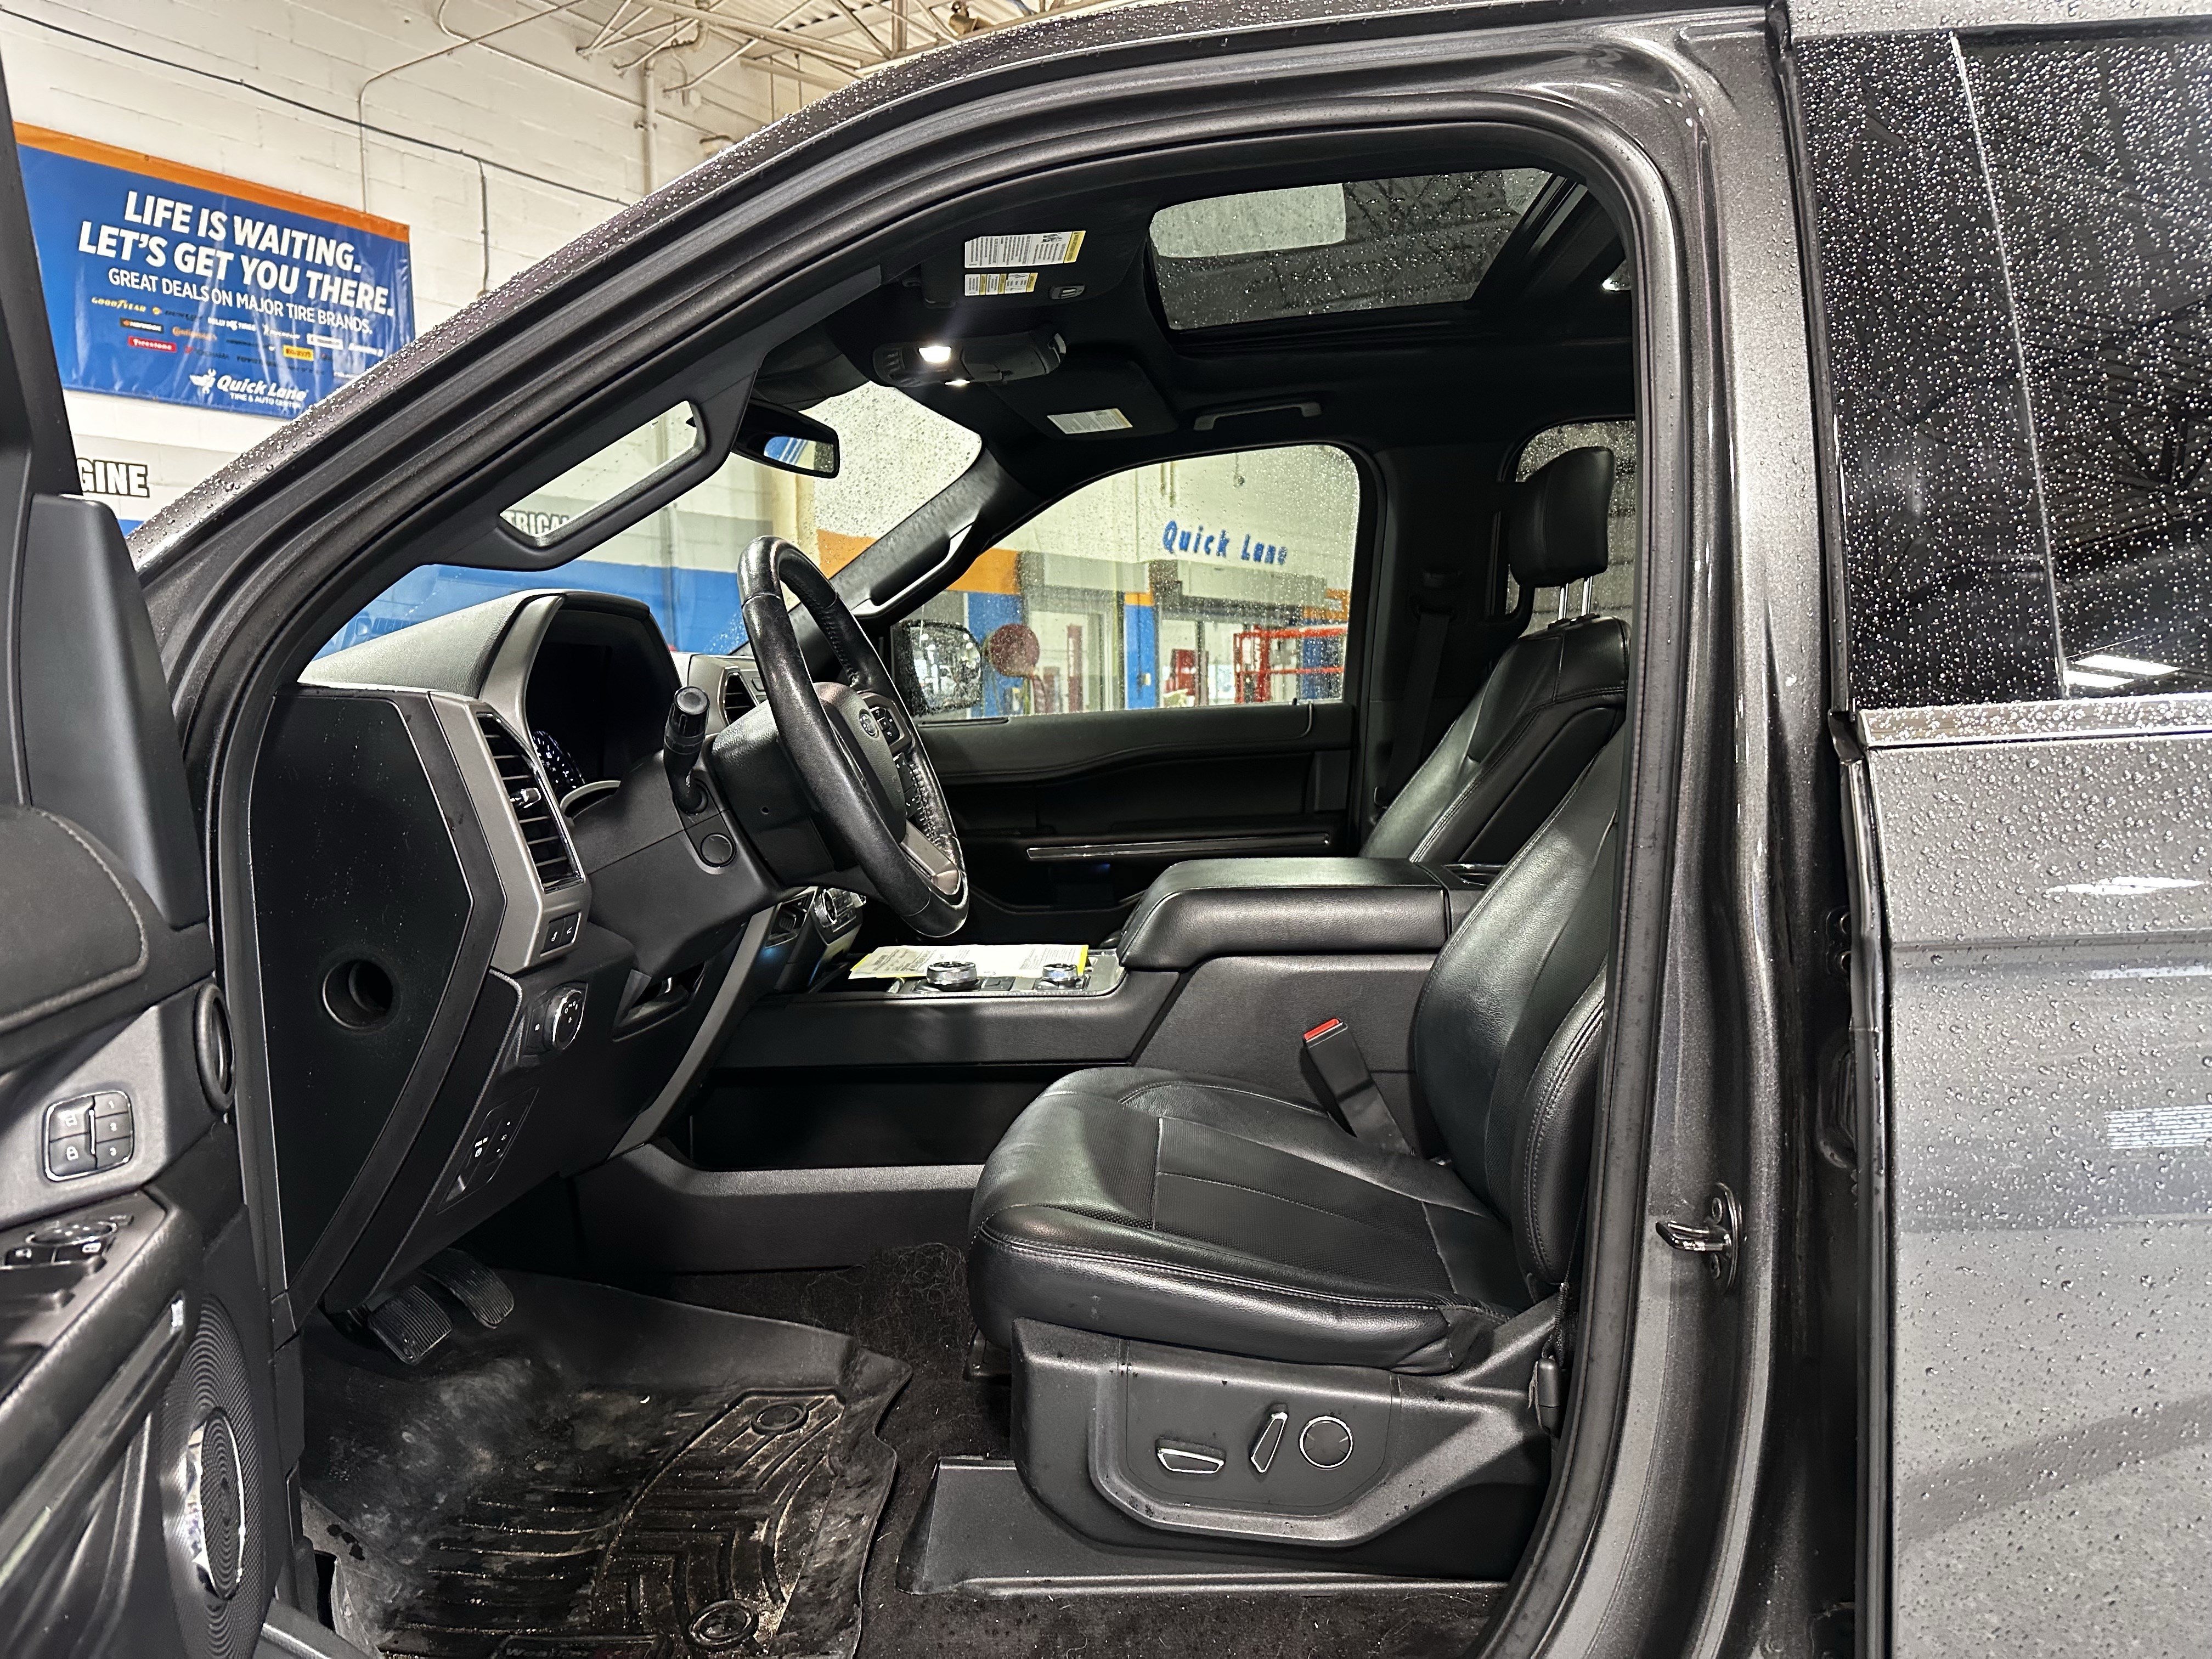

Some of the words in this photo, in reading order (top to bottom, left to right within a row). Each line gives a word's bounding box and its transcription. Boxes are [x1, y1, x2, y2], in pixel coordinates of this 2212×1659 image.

[125, 190, 193, 234] LIFE
[198, 208, 228, 241] IS
[233, 215, 362, 273] WAITING.
[78, 221, 168, 267] LET’S
[174, 242, 234, 280] GET
[240, 255, 300, 294] YOU
[306, 269, 394, 317] THERE.
[108, 268, 159, 292] GREAT
[161, 278, 210, 302] DEALS
[211, 287, 233, 307] ON
[236, 292, 284, 317] MAJOR
[286, 303, 315, 323] TIRE
[317, 309, 373, 334] BRANDS.
[217, 375, 268, 395] Quick
[267, 382, 307, 402] Lane
[229, 392, 247, 401] TIRE
[254, 396, 274, 405] AUTO
[1162, 520, 1230, 557] Quick
[1240, 533, 1288, 566] Lane
